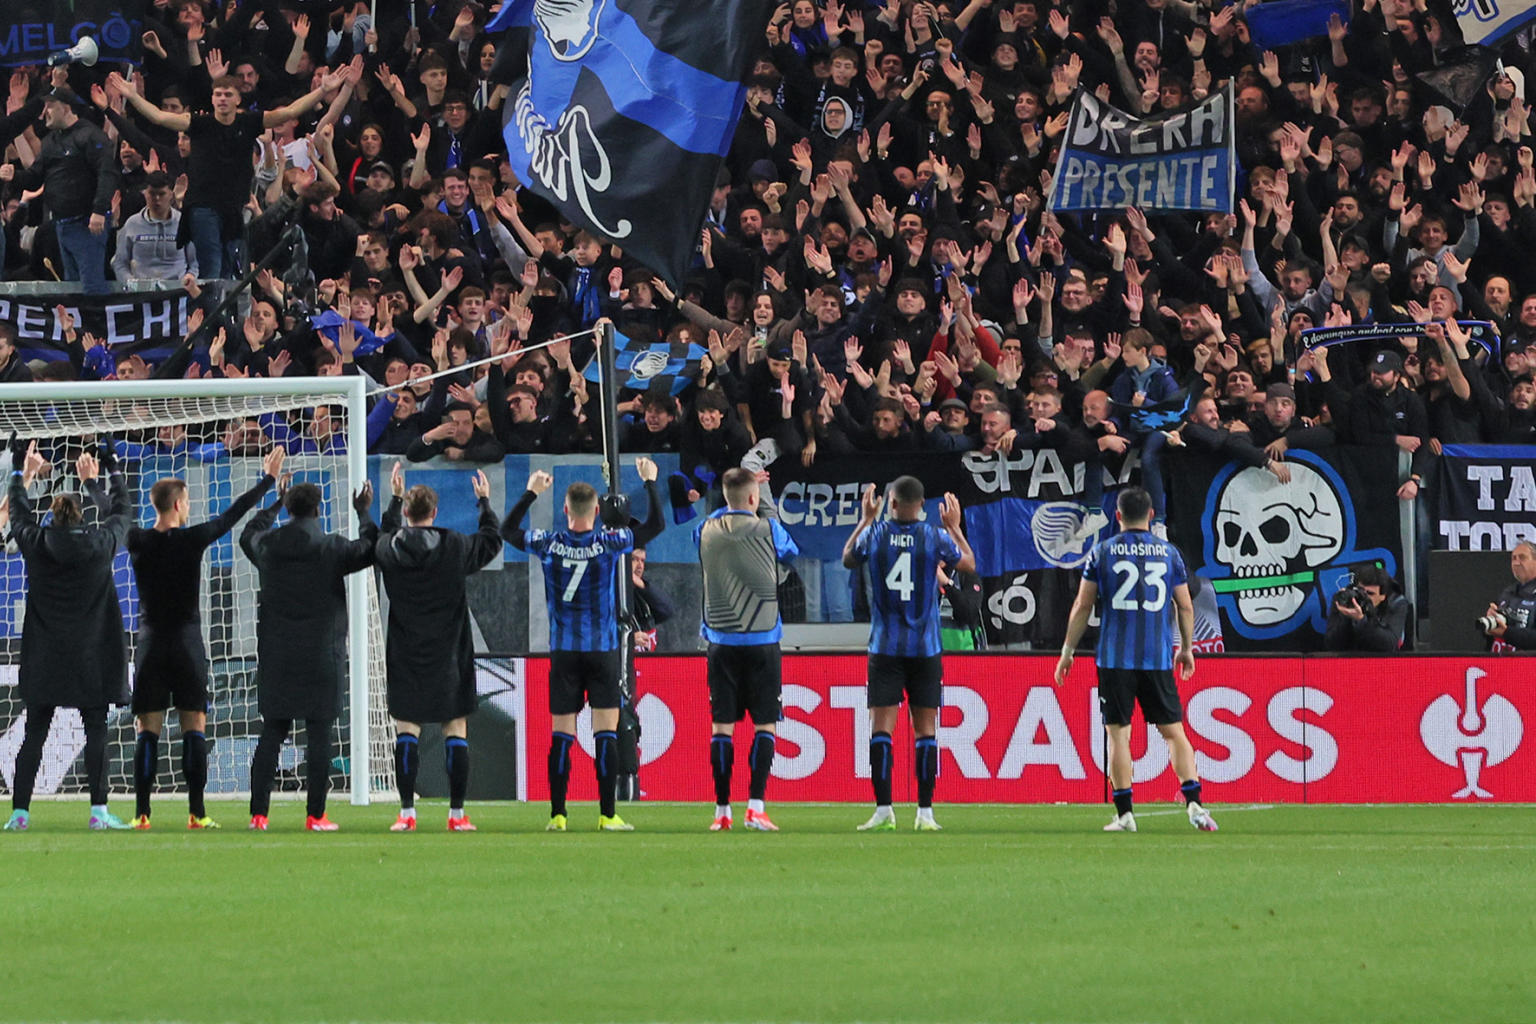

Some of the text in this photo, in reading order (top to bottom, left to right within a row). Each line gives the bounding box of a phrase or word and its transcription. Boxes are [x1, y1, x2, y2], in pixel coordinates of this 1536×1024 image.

[1060, 155, 1219, 210] PRESENTE
[104, 295, 190, 345] CHI
[562, 558, 590, 603] 7
[884, 552, 916, 602] 4
[1111, 560, 1168, 613] 23
